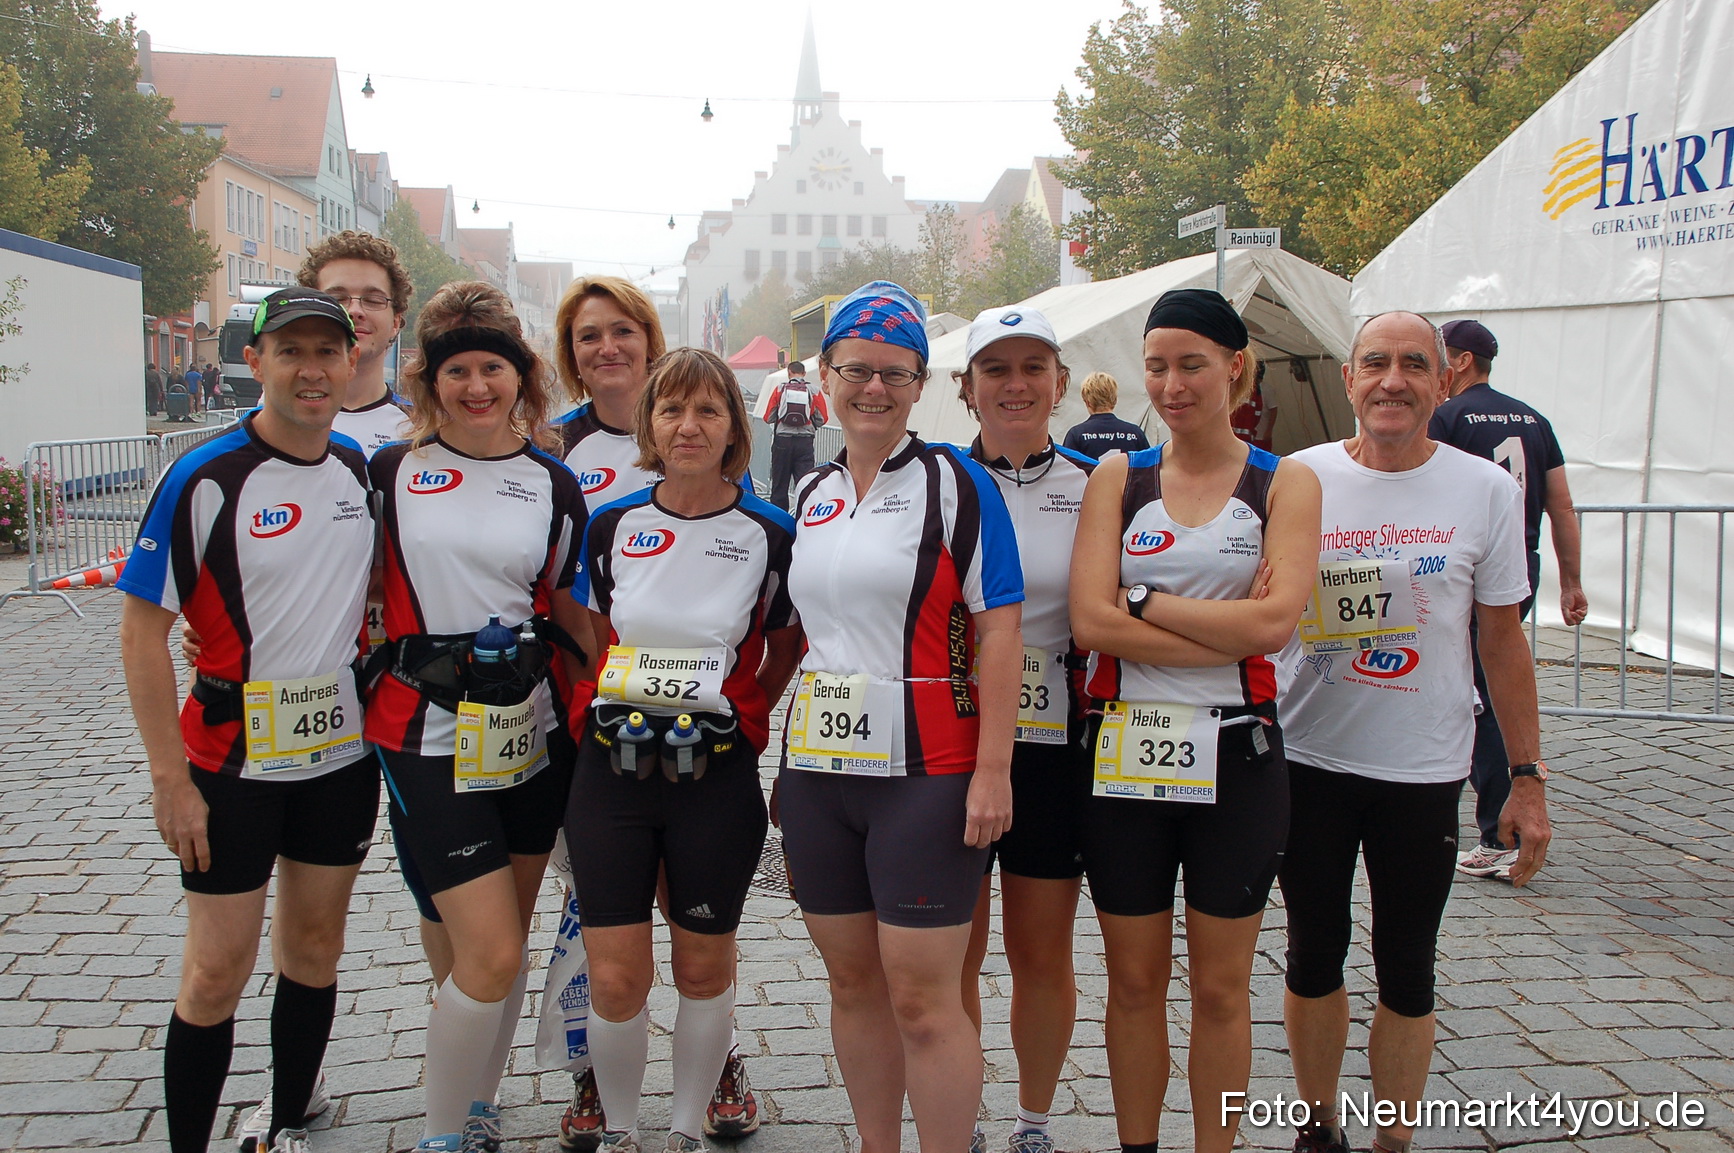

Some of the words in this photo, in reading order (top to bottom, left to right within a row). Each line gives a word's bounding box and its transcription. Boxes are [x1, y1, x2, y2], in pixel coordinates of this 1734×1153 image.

[1592, 214, 1660, 236] GETRÄNKE
[1670, 203, 1717, 224] WEINE
[1231, 231, 1276, 247] Rainbügl
[1464, 413, 1488, 424] The
[1488, 414, 1508, 424] way
[1509, 413, 1521, 422] to
[1523, 415, 1538, 424] go.
[1082, 432, 1098, 440] The
[412, 470, 448, 485] tkn
[504, 478, 522, 488] team
[576, 472, 602, 486] kn
[496, 490, 529, 502] nürnberg
[508, 486, 538, 498] klinikum
[807, 502, 834, 516] tkn
[884, 498, 910, 507] klinikum
[871, 506, 900, 514] nürnberg
[1039, 506, 1072, 514] nürnberg
[252, 508, 288, 528] tkn
[627, 532, 660, 548] tkn
[715, 538, 734, 546] team
[1130, 531, 1162, 546] tkn
[1380, 524, 1456, 546] Silvesterlauf
[718, 544, 750, 555] klinikum
[1219, 548, 1251, 556] nürnberg
[1232, 542, 1258, 550] klinikum
[705, 550, 739, 562] nürnberg
[1414, 556, 1447, 576] 2006
[1320, 566, 1382, 588] Herbert
[1337, 592, 1392, 622] 847
[1372, 632, 1417, 644] PFLEIDERER
[638, 654, 719, 671] Rosemarie
[1360, 649, 1403, 672] tkn
[644, 676, 700, 701] 352
[814, 679, 850, 700] Gerda
[1358, 679, 1382, 688] klinikum
[1384, 684, 1408, 692] nürnberg
[280, 683, 340, 705] Andreas
[252, 716, 260, 730] B
[293, 705, 344, 738] 486
[489, 704, 535, 730] Manuela
[1131, 708, 1171, 728] Heike
[820, 711, 872, 740] 394
[1024, 726, 1065, 738] PFLEIDERER
[322, 740, 361, 756] PFLEIDERER
[461, 737, 468, 750] D
[499, 724, 538, 760] 487
[1102, 736, 1109, 749] D
[1138, 739, 1196, 768] 323
[844, 758, 888, 769] PFLEIDERER
[1166, 785, 1214, 796] PFLEIDERER
[448, 850, 462, 858] PRO
[686, 909, 716, 919] adidas
